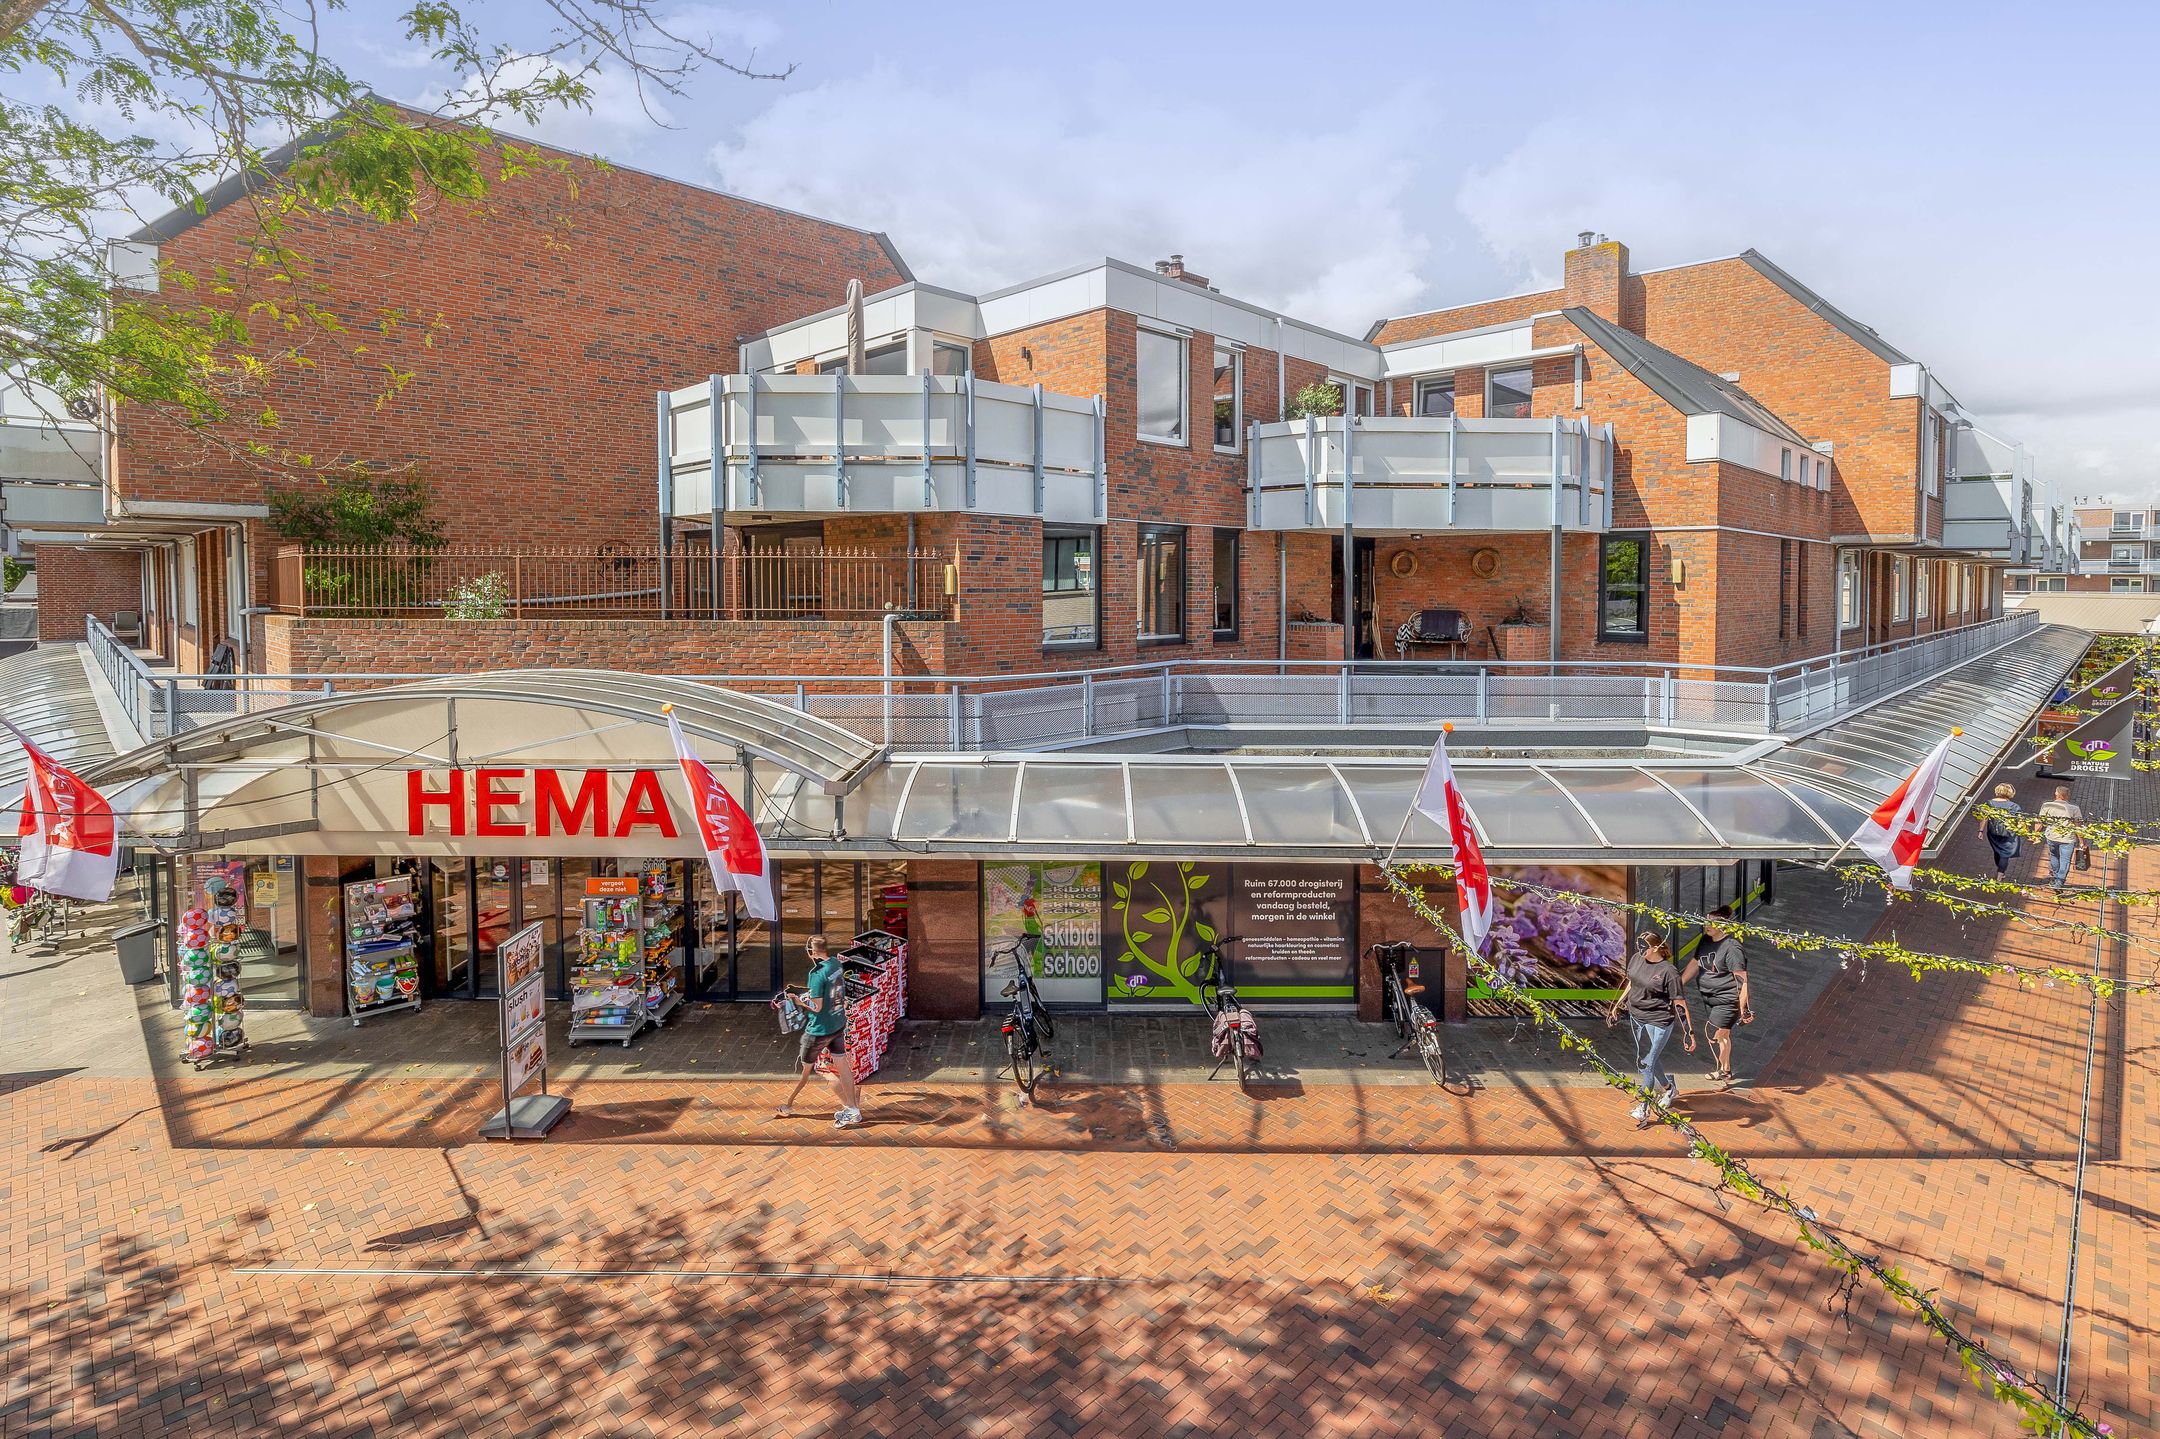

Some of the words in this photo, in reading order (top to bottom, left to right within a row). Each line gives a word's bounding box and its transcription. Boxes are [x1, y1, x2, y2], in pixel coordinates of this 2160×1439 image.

[2086, 740, 2103, 752] dn
[2070, 765, 2110, 773] DROGIST
[408, 768, 679, 838] HEMA
[1244, 879, 1266, 888] Ruim
[1267, 879, 1297, 888] 67.000
[1298, 879, 1343, 889] drogisterij
[1263, 890, 1336, 900] reformproducten
[1256, 901, 1295, 911] vandaag
[1296, 901, 1330, 910] besteld,
[1251, 914, 1285, 922] morgen
[1286, 912, 1295, 920] in
[1296, 912, 1307, 920] de
[1308, 912, 1336, 920] winkel
[1044, 920, 1101, 946] skibidi
[1130, 975, 1143, 988] dn
[508, 991, 528, 1011] slush
